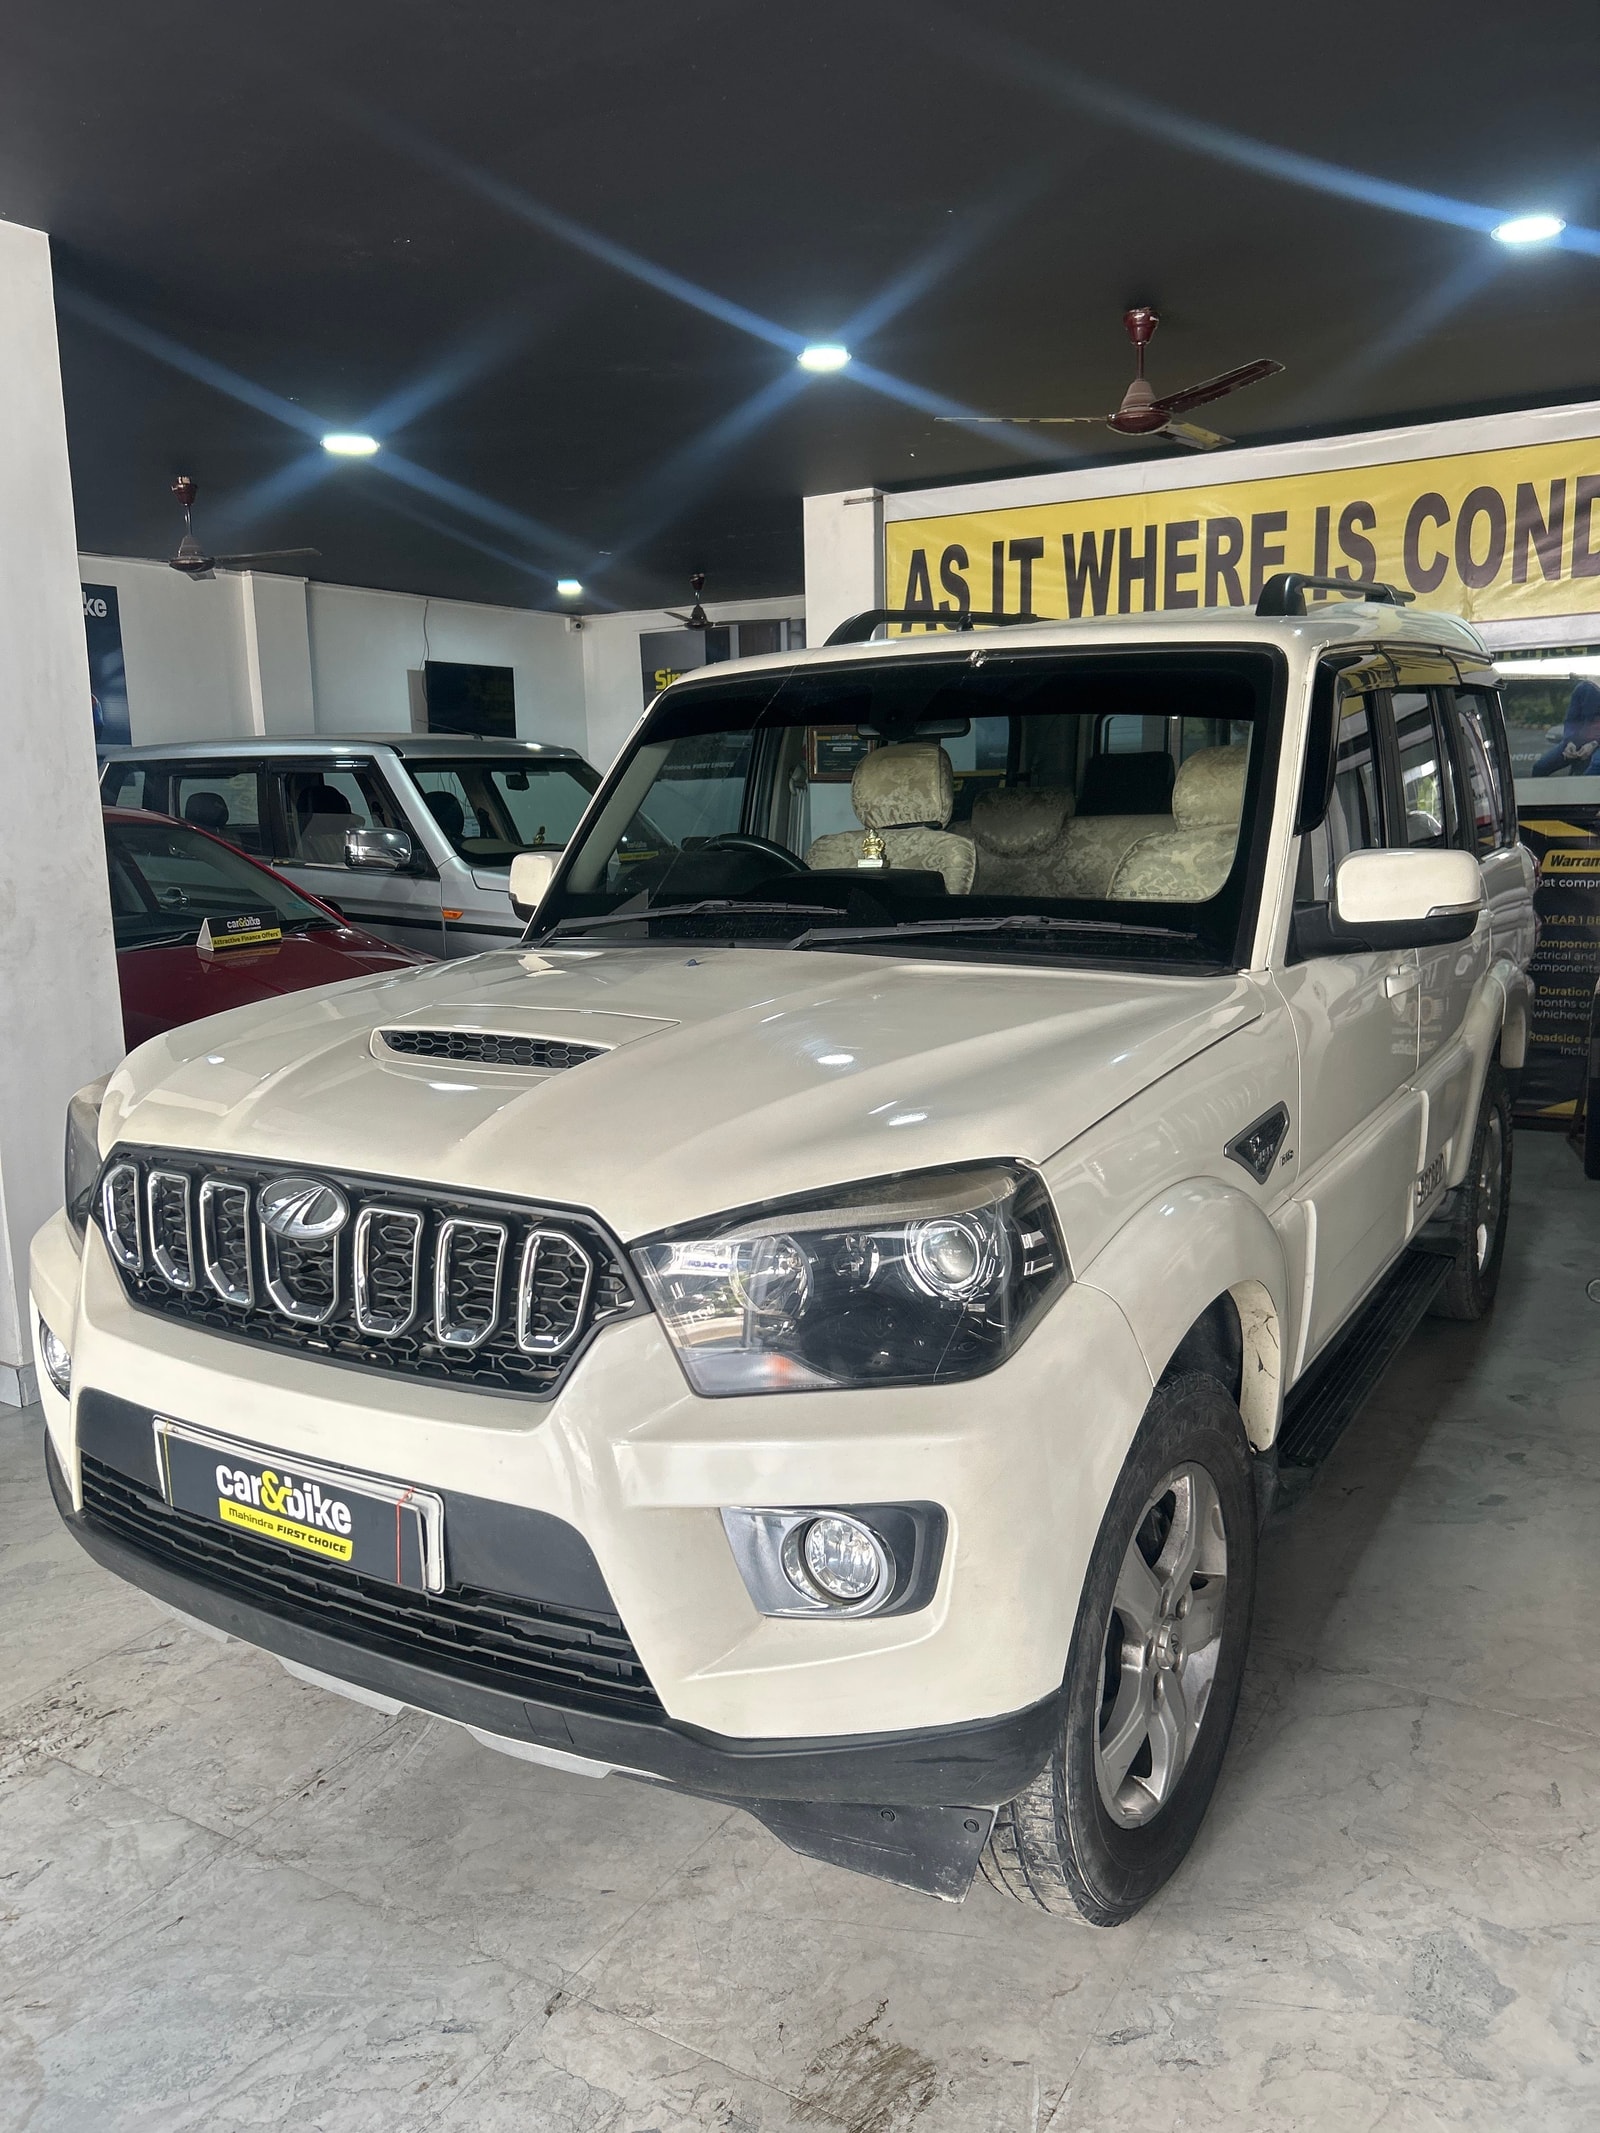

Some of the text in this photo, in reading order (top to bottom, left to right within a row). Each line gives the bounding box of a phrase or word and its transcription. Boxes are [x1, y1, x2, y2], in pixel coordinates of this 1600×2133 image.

[900, 543, 970, 632] AS
[991, 536, 1044, 617] IT
[1062, 511, 1287, 620] WHERE
[1313, 500, 1377, 600] IS
[1539, 985, 1591, 997] Duration
[215, 1464, 352, 1534] car&bike
[228, 1507, 347, 1554] Mahindra FIRST CHOICE
